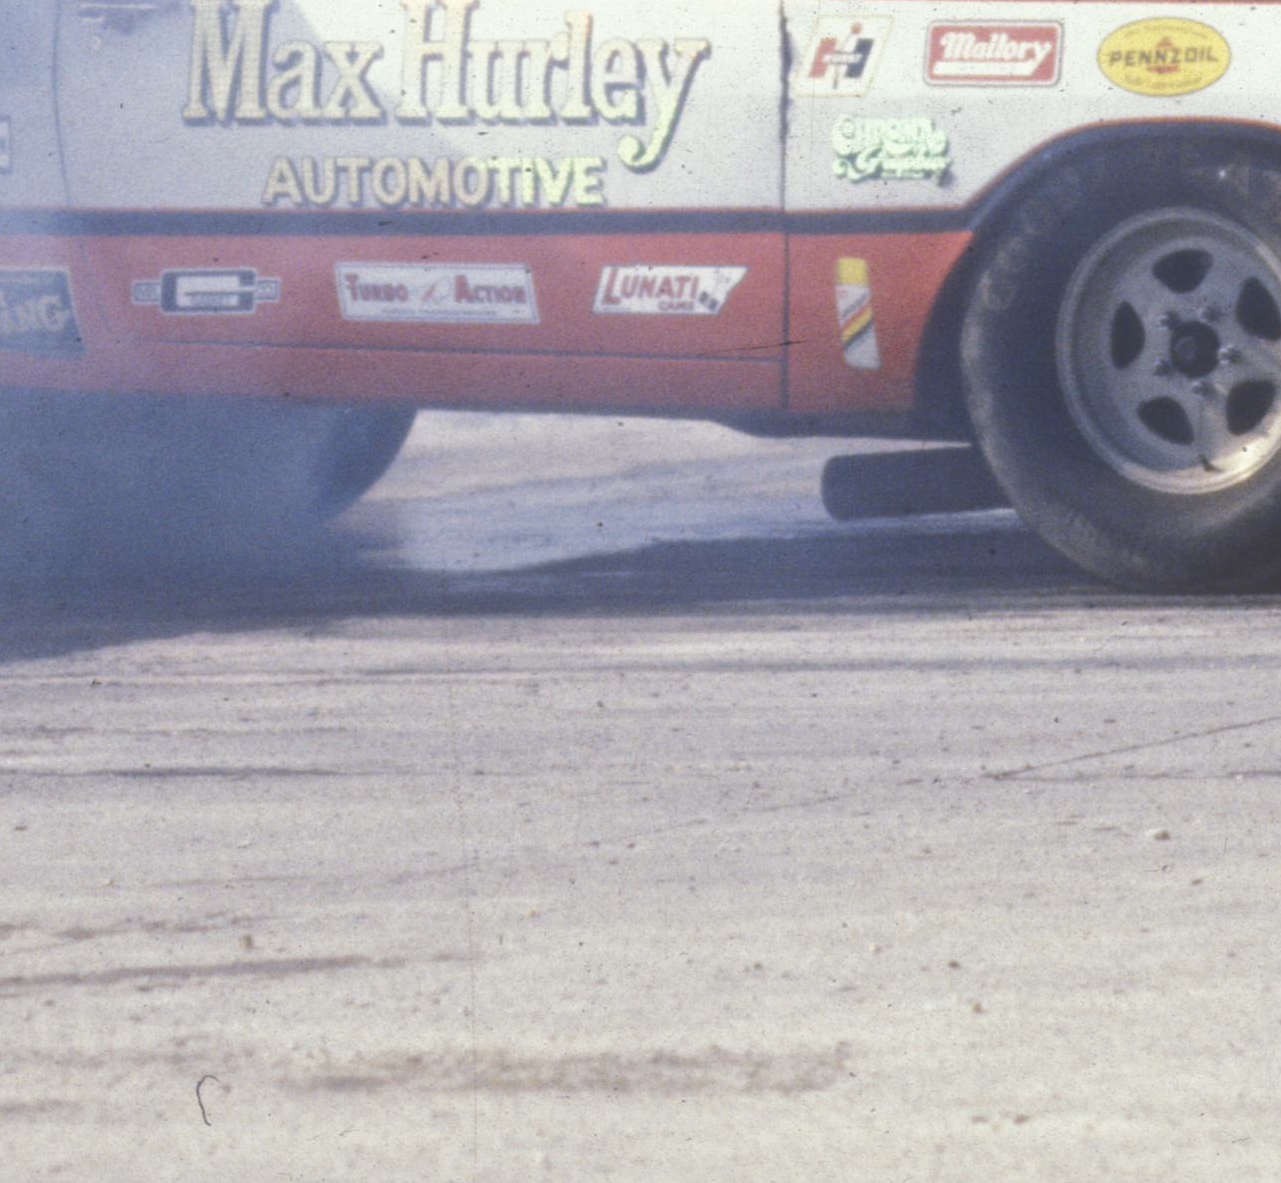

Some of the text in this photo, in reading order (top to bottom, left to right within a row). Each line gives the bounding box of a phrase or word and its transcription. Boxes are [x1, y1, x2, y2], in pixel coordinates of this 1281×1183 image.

[939, 31, 1053, 63] Mallory
[1108, 46, 1219, 67] PENNZOIL
[261, 156, 606, 207] AUTOMOTIVE
[601, 267, 701, 305] LUNATI
